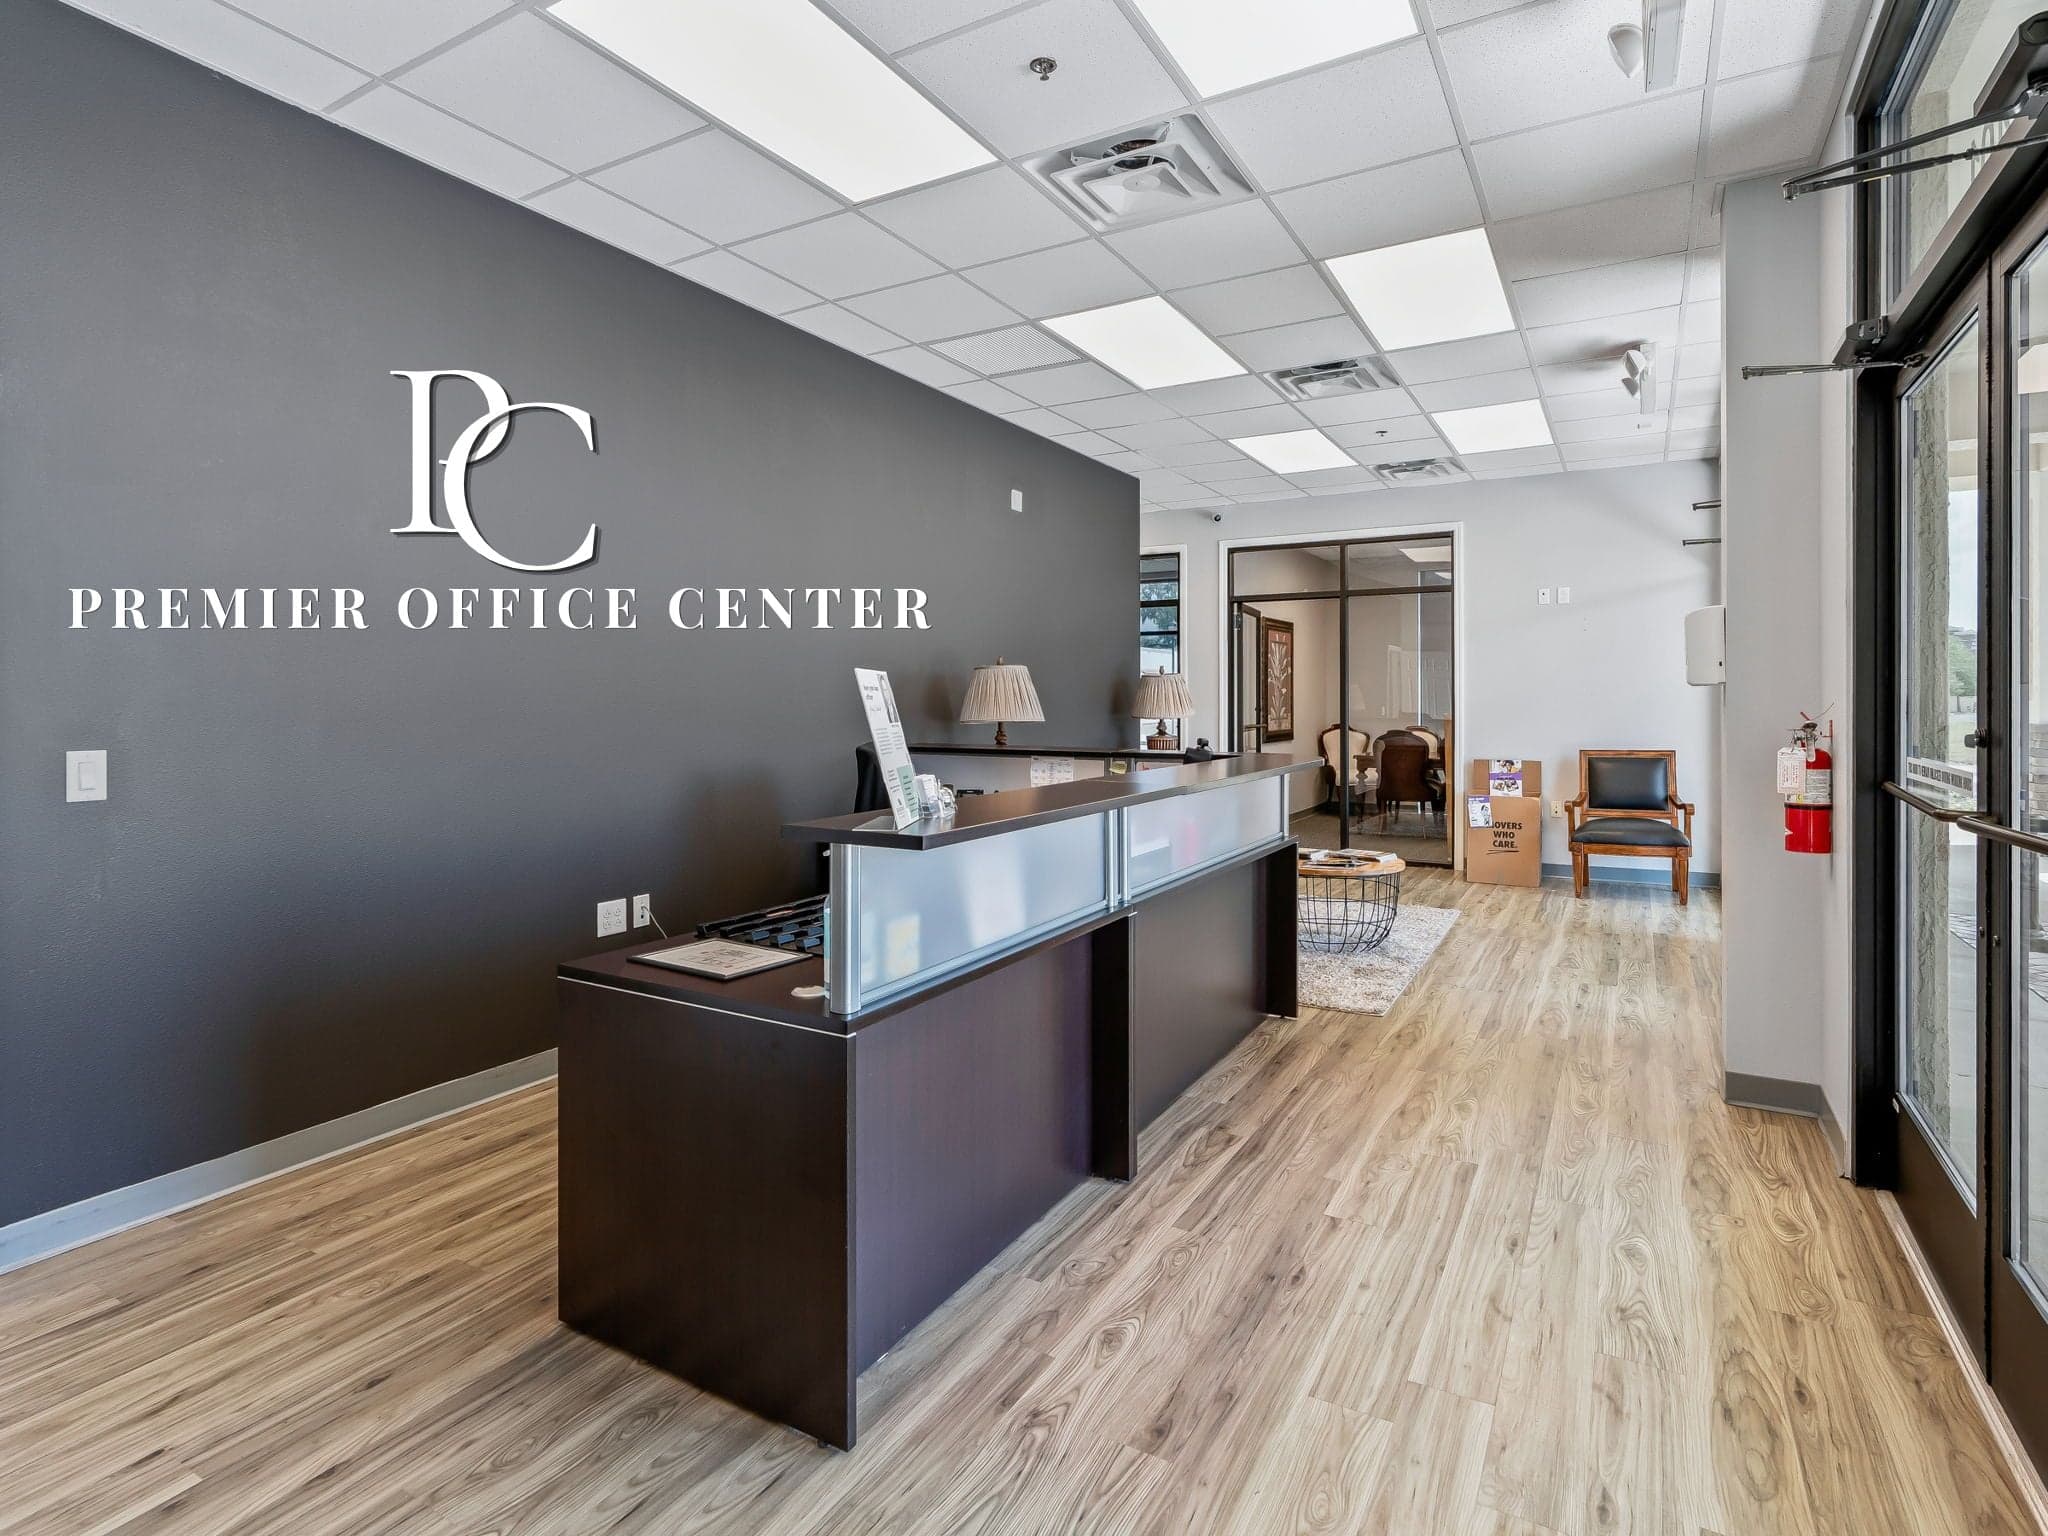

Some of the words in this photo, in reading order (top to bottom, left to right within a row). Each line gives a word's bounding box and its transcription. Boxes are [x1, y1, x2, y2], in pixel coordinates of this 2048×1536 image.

[389, 369, 598, 573] PC
[68, 587, 369, 630] PREMIER
[397, 586, 638, 630] OFFICE
[668, 586, 932, 630] CENTER
[1487, 821, 1523, 830] OVERS
[1493, 830, 1515, 839] WHO
[1492, 840, 1518, 849] CARE.
